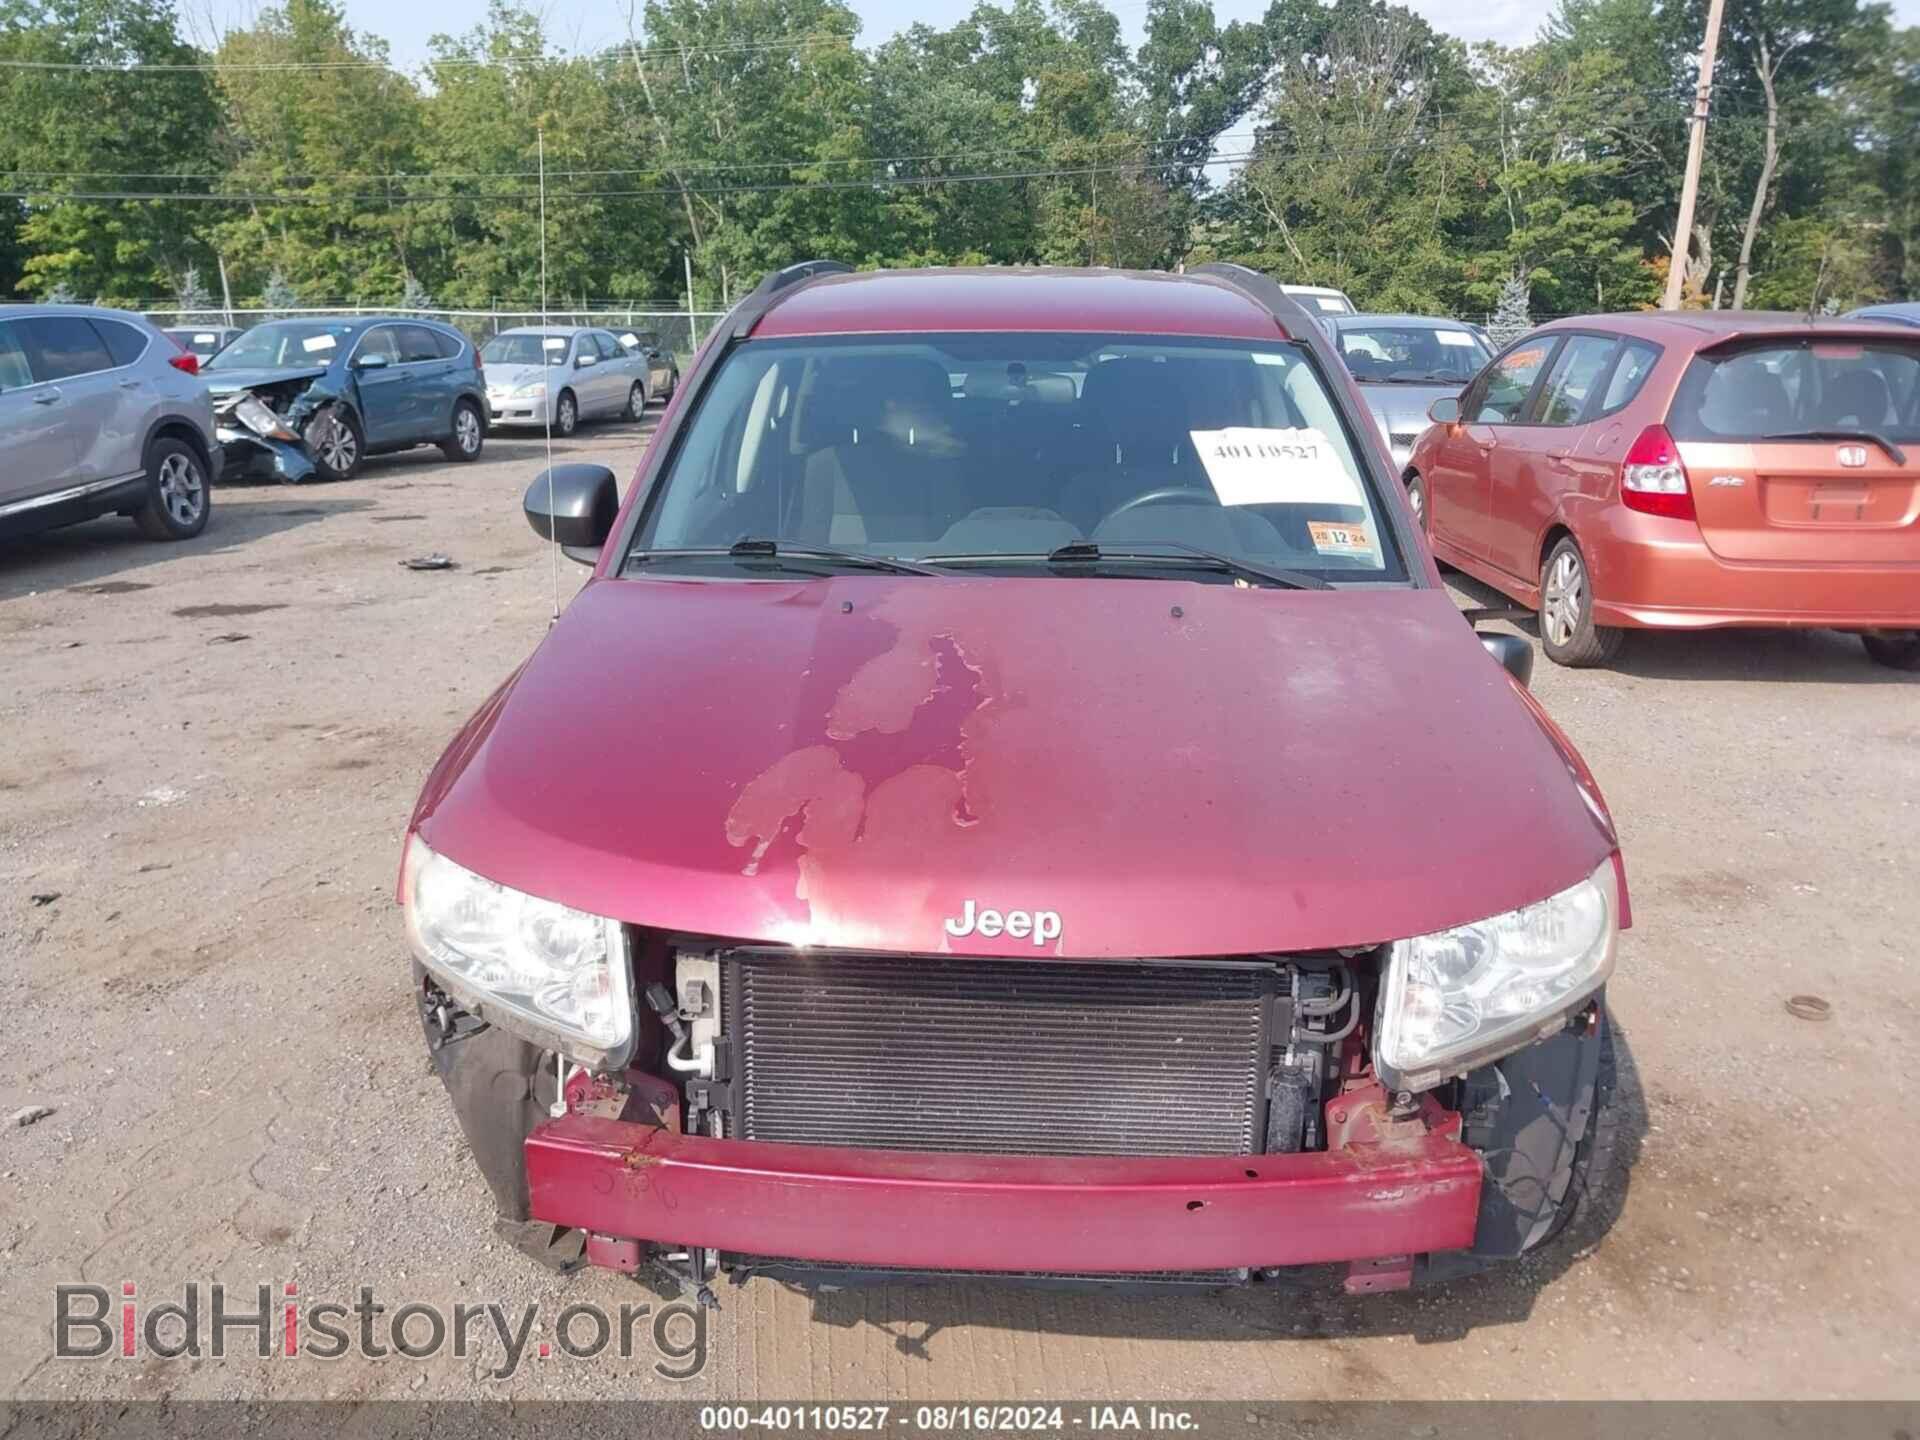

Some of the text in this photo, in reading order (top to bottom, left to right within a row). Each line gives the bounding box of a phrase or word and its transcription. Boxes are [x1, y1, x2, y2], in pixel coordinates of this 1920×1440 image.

[1214, 443, 1319, 460] 40110527
[1331, 530, 1349, 543] 12
[944, 899, 1062, 946] Jeep
